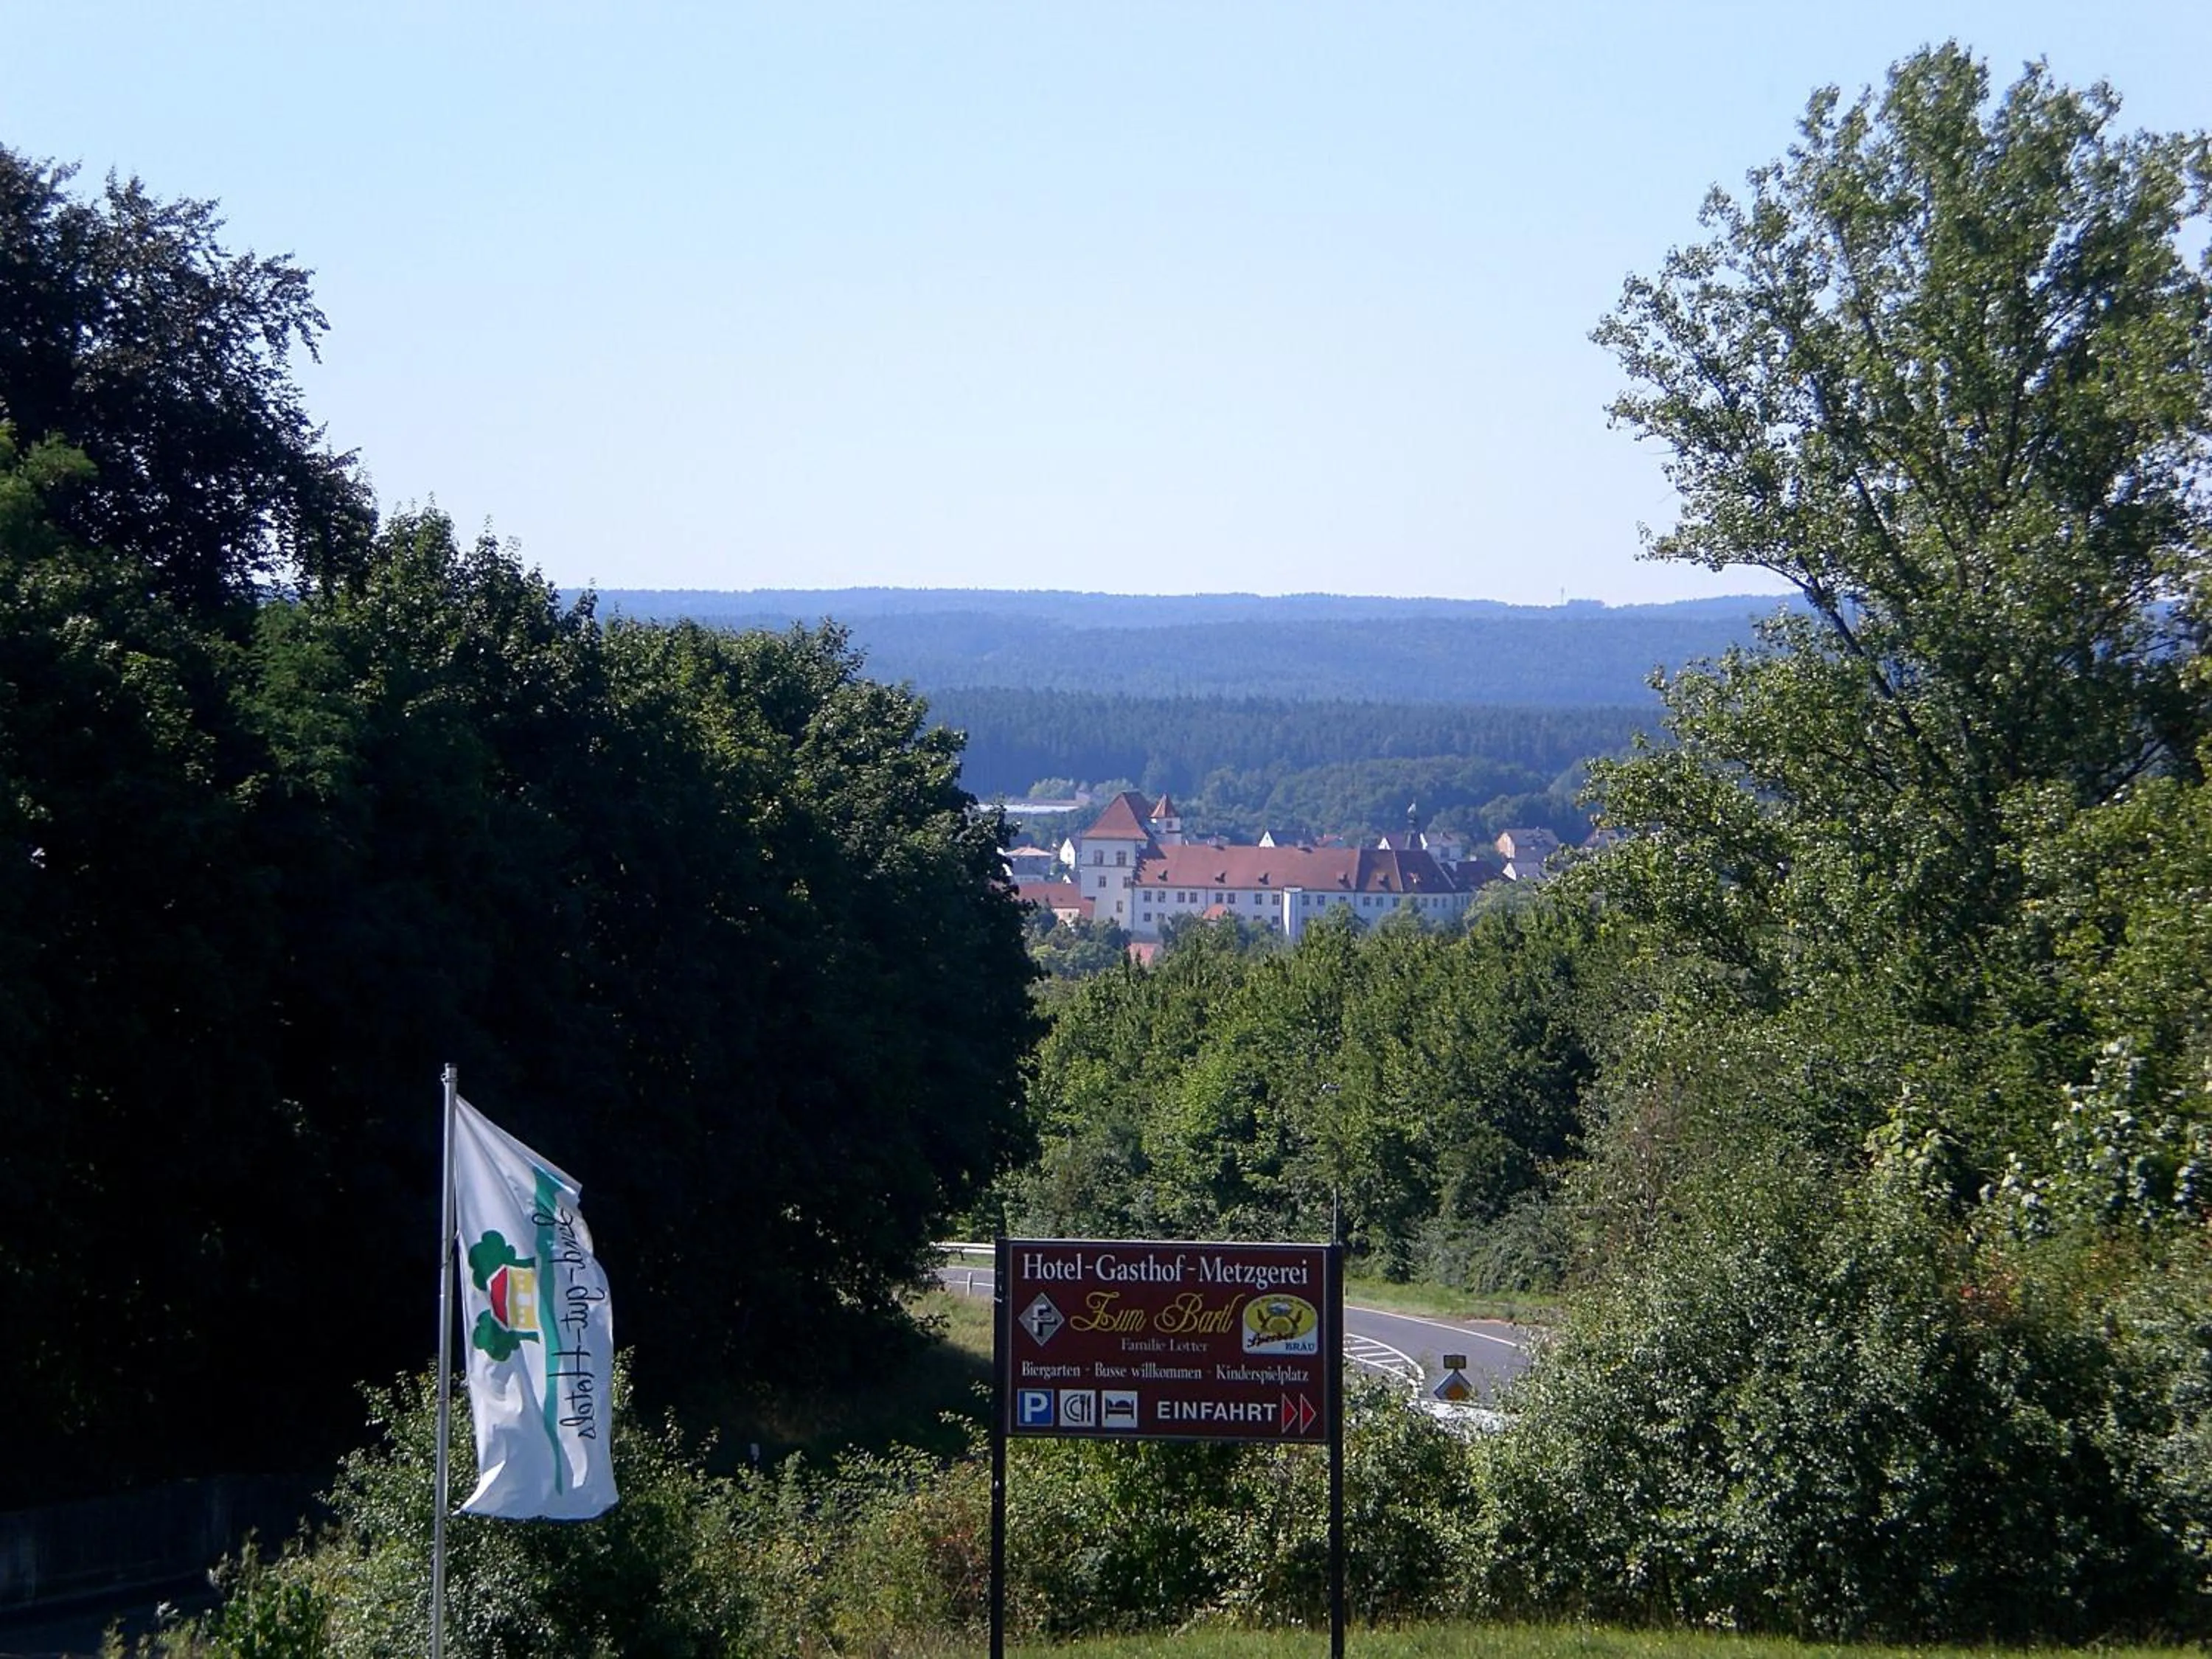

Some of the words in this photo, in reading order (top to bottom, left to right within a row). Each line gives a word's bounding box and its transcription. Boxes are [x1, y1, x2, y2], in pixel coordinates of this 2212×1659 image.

[1070, 1291, 1147, 1332] Zum
[1121, 1338, 1166, 1351] Familie
[1021, 1360, 1080, 1379] Biergarten
[1095, 1362, 1127, 1377] Busse
[1131, 1363, 1202, 1380] willkommen
[1216, 1364, 1309, 1385] Kinderspielplatz
[1023, 1392, 1048, 1422] P
[1157, 1401, 1277, 1422] EINFAHRT
